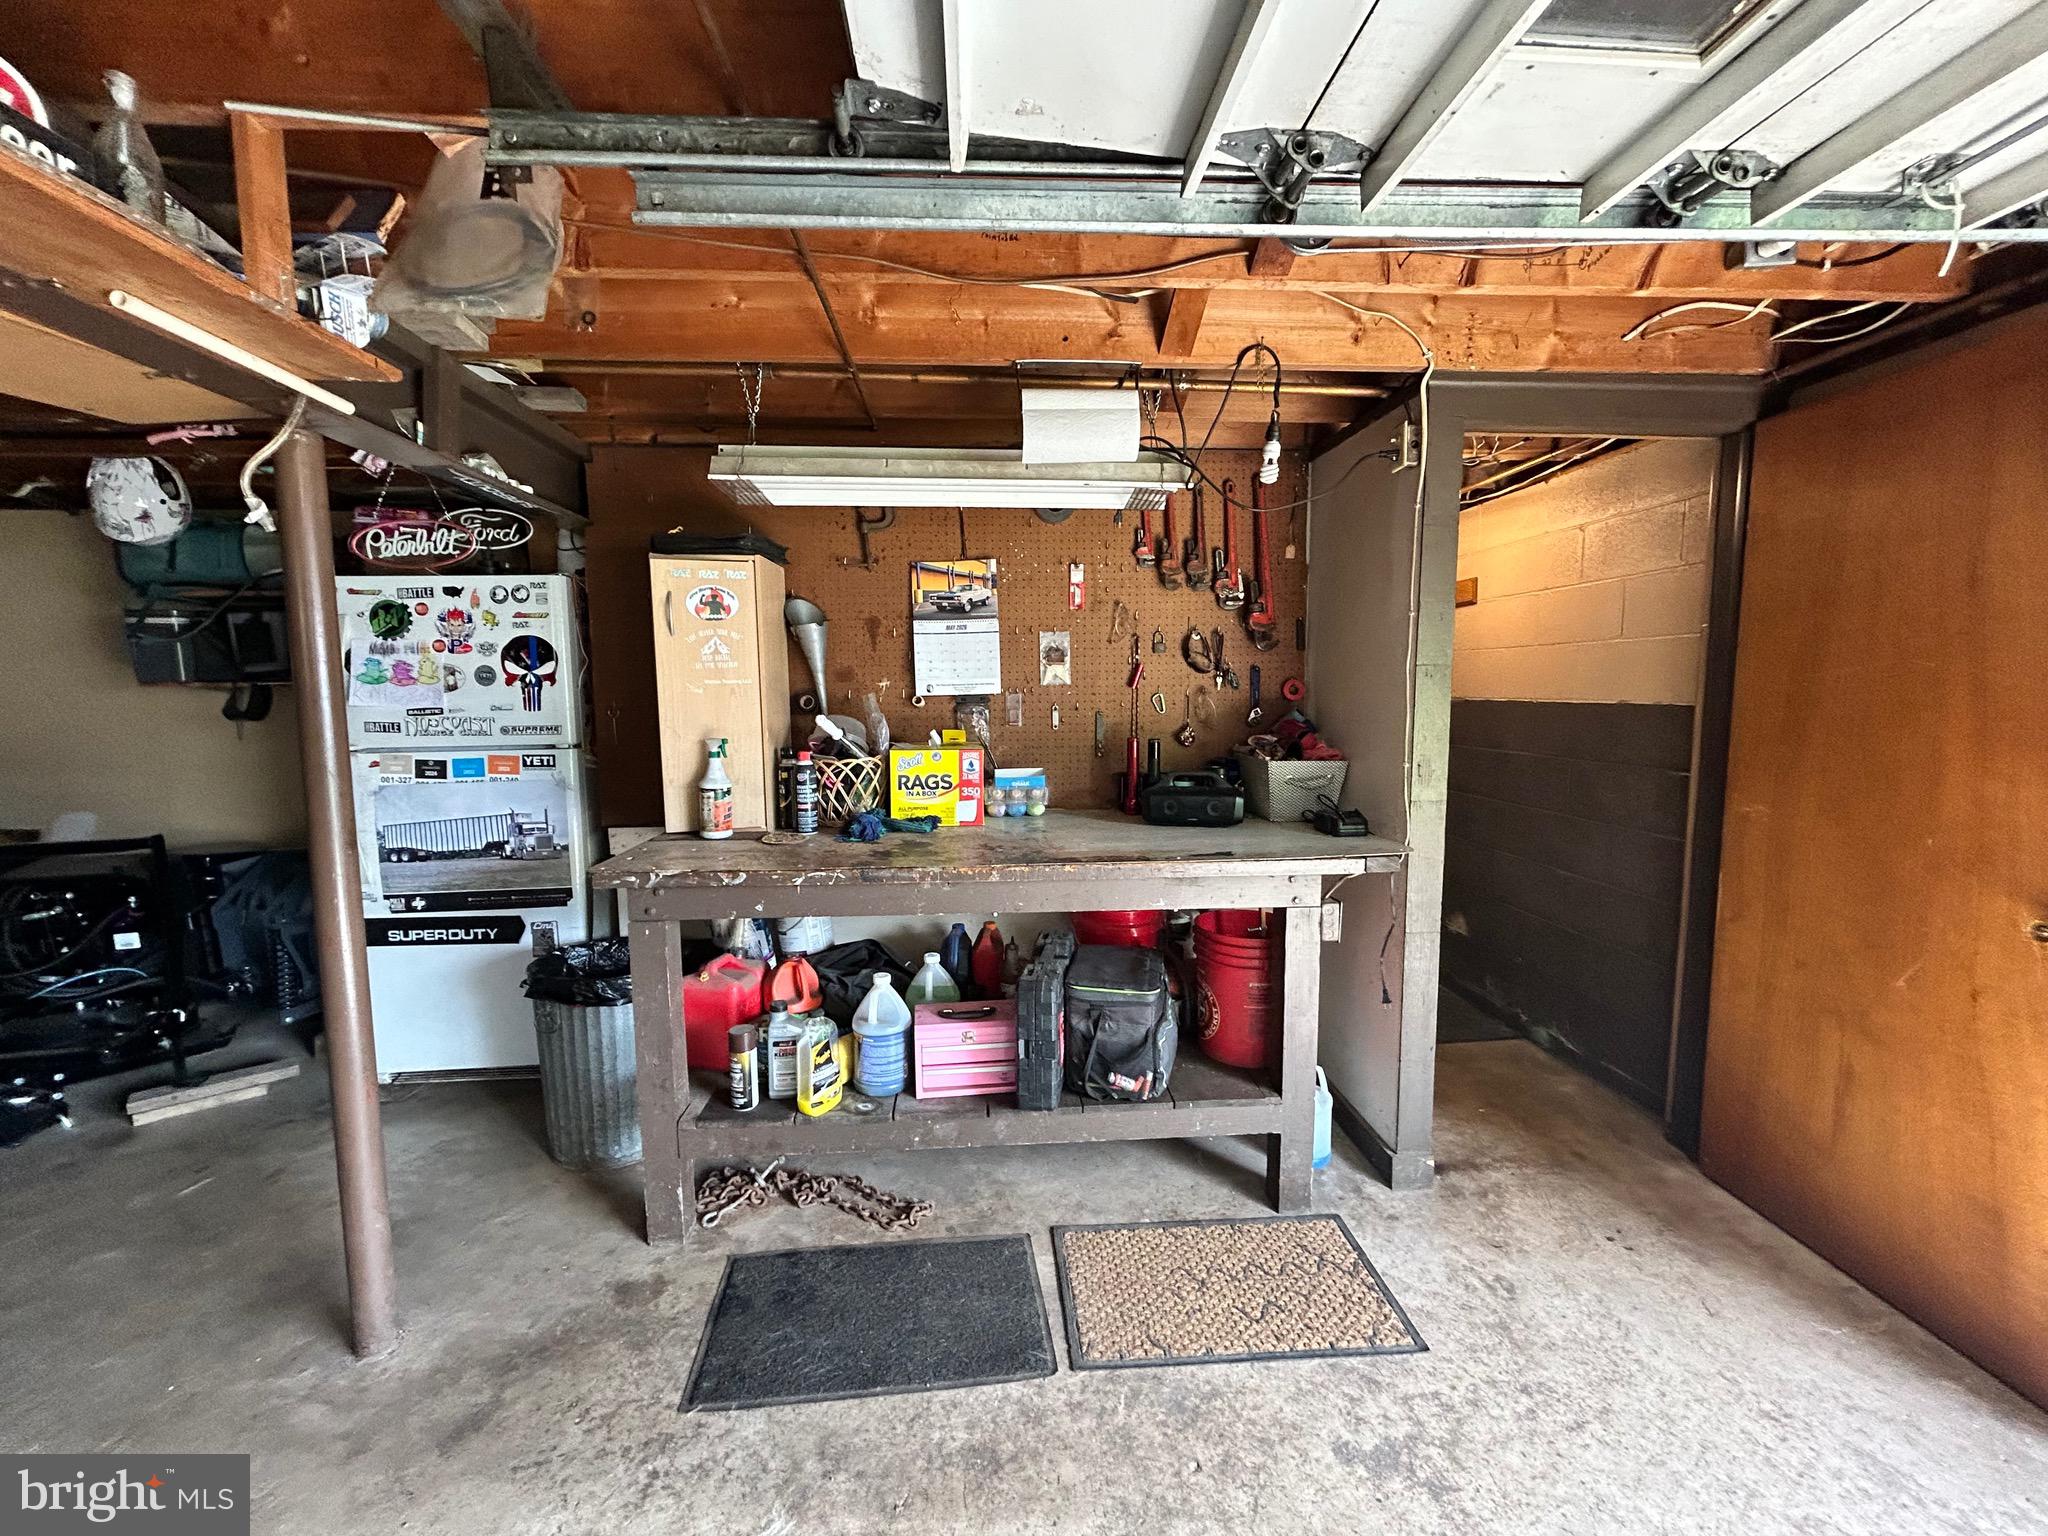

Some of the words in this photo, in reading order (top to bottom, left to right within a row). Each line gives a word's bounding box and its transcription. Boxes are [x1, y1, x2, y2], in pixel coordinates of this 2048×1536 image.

[328, 291, 345, 340] USCH
[365, 527, 459, 559] Peterbilt
[524, 757, 554, 766] YETI
[897, 753, 923, 771] Scott
[898, 774, 953, 790] RAGS
[961, 787, 980, 796] 350
